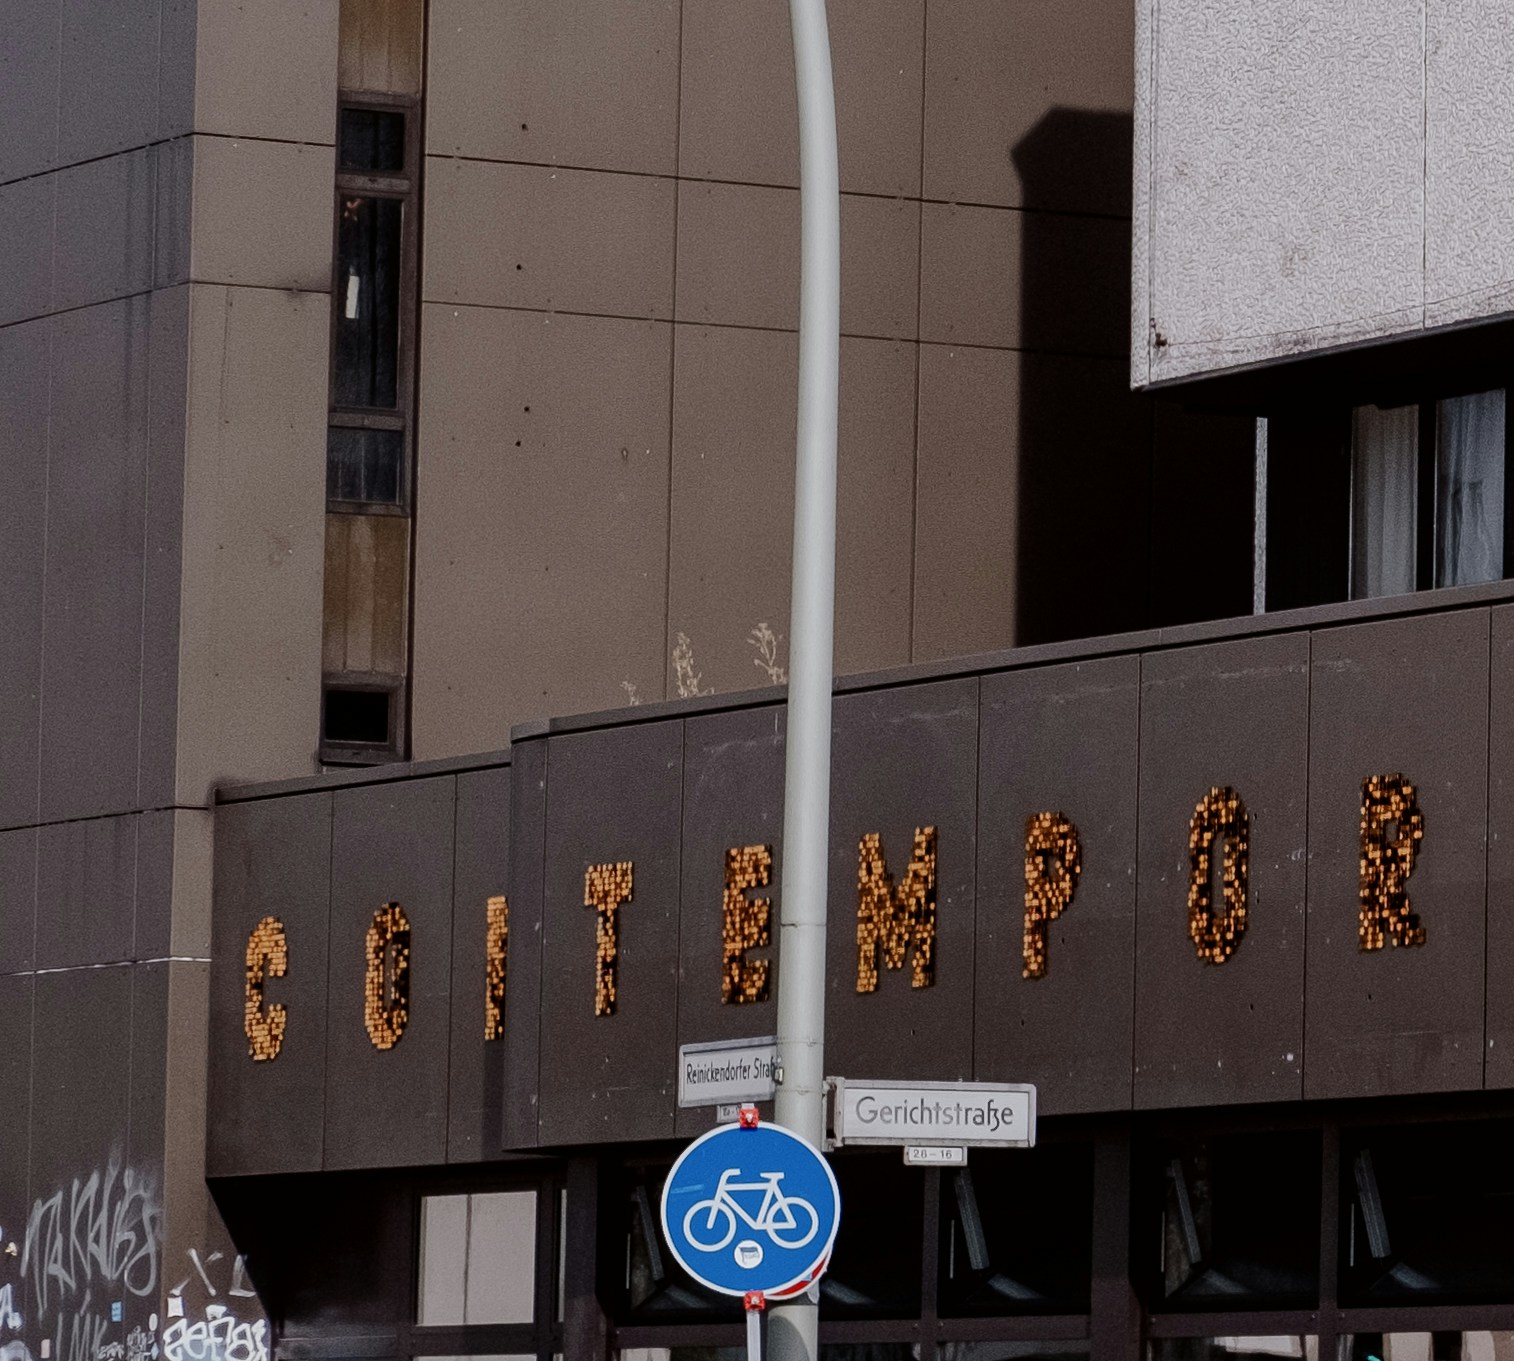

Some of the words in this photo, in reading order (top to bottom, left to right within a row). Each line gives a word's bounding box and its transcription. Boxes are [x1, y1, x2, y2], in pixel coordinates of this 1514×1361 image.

[686, 1058, 751, 1084] Reinickendorfer
[753, 1056, 776, 1080] Straß
[855, 1095, 1014, 1131] Gerichtstraße
